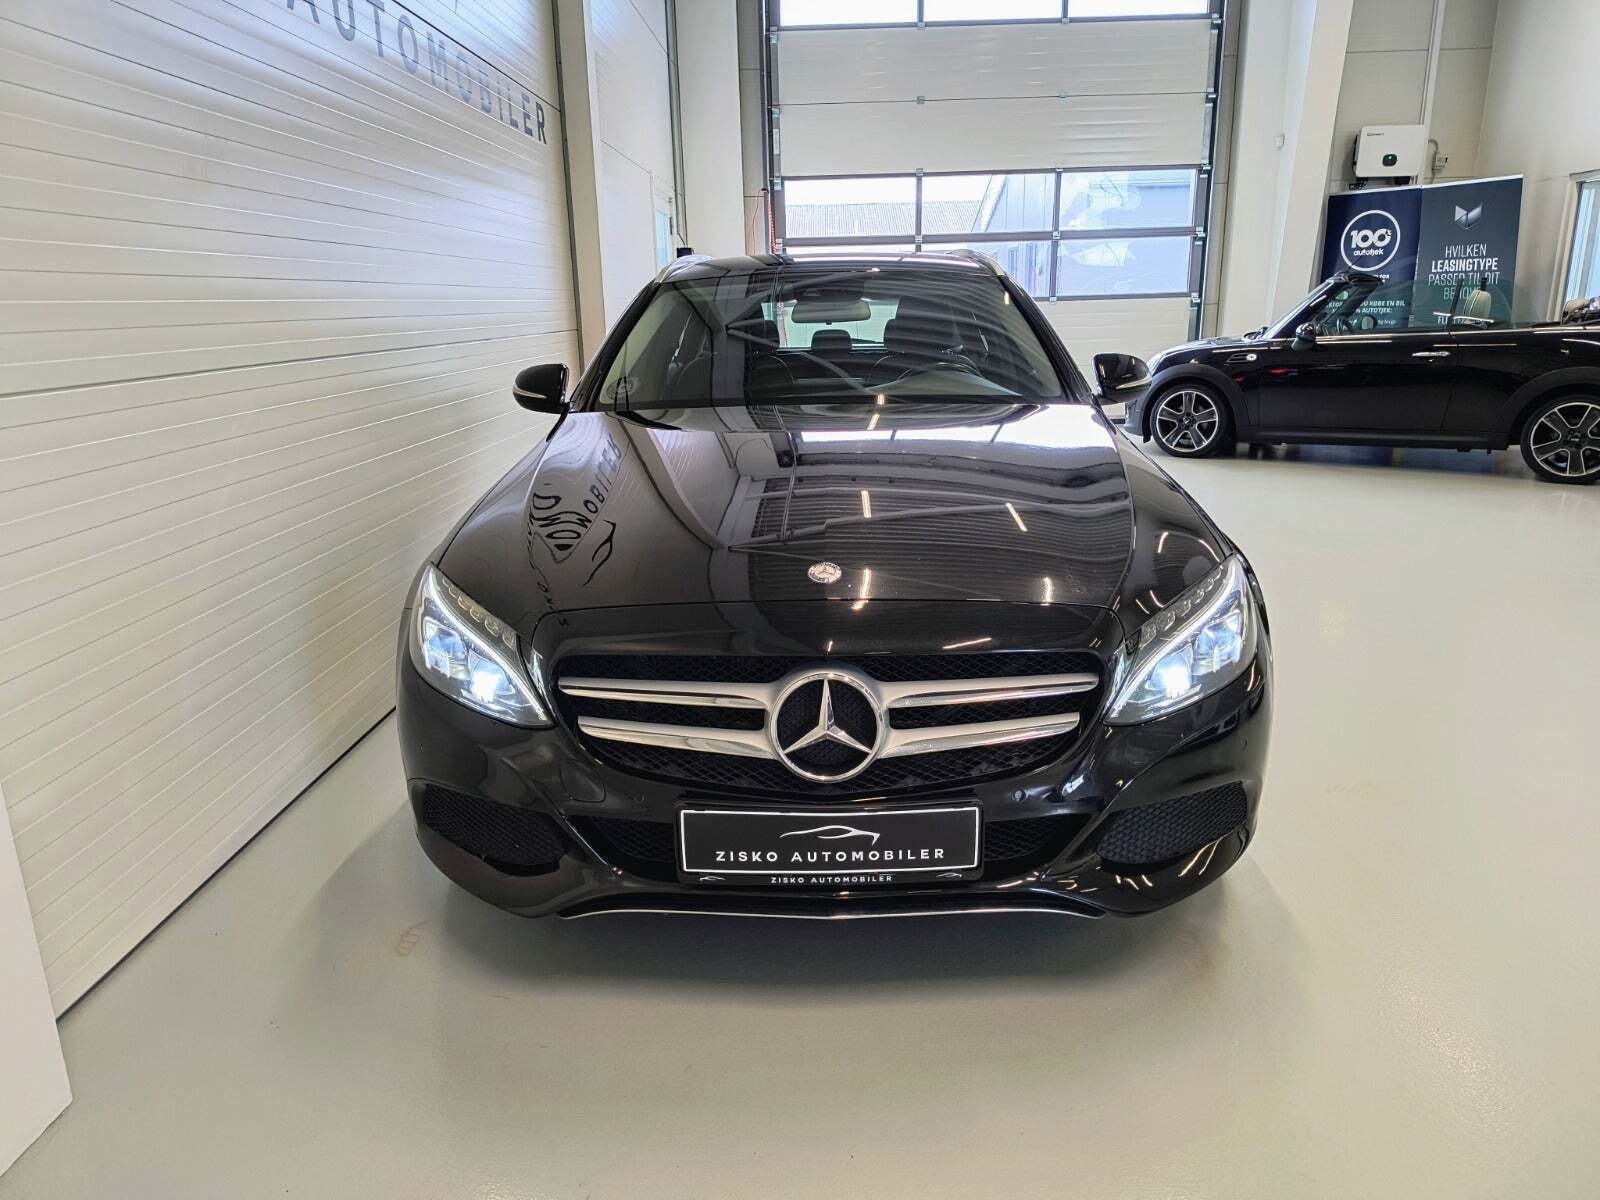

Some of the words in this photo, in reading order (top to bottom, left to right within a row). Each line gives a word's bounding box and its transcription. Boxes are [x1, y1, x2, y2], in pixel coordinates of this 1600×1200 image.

[1445, 243, 1487, 258] HVILKEN
[1431, 257, 1499, 273] LEASINGTYPE
[715, 850, 778, 862] ZISKO
[790, 848, 945, 863] AUTOMOBILER
[770, 876, 805, 884] ZISKO
[810, 874, 893, 884] AUTOMOBILER
